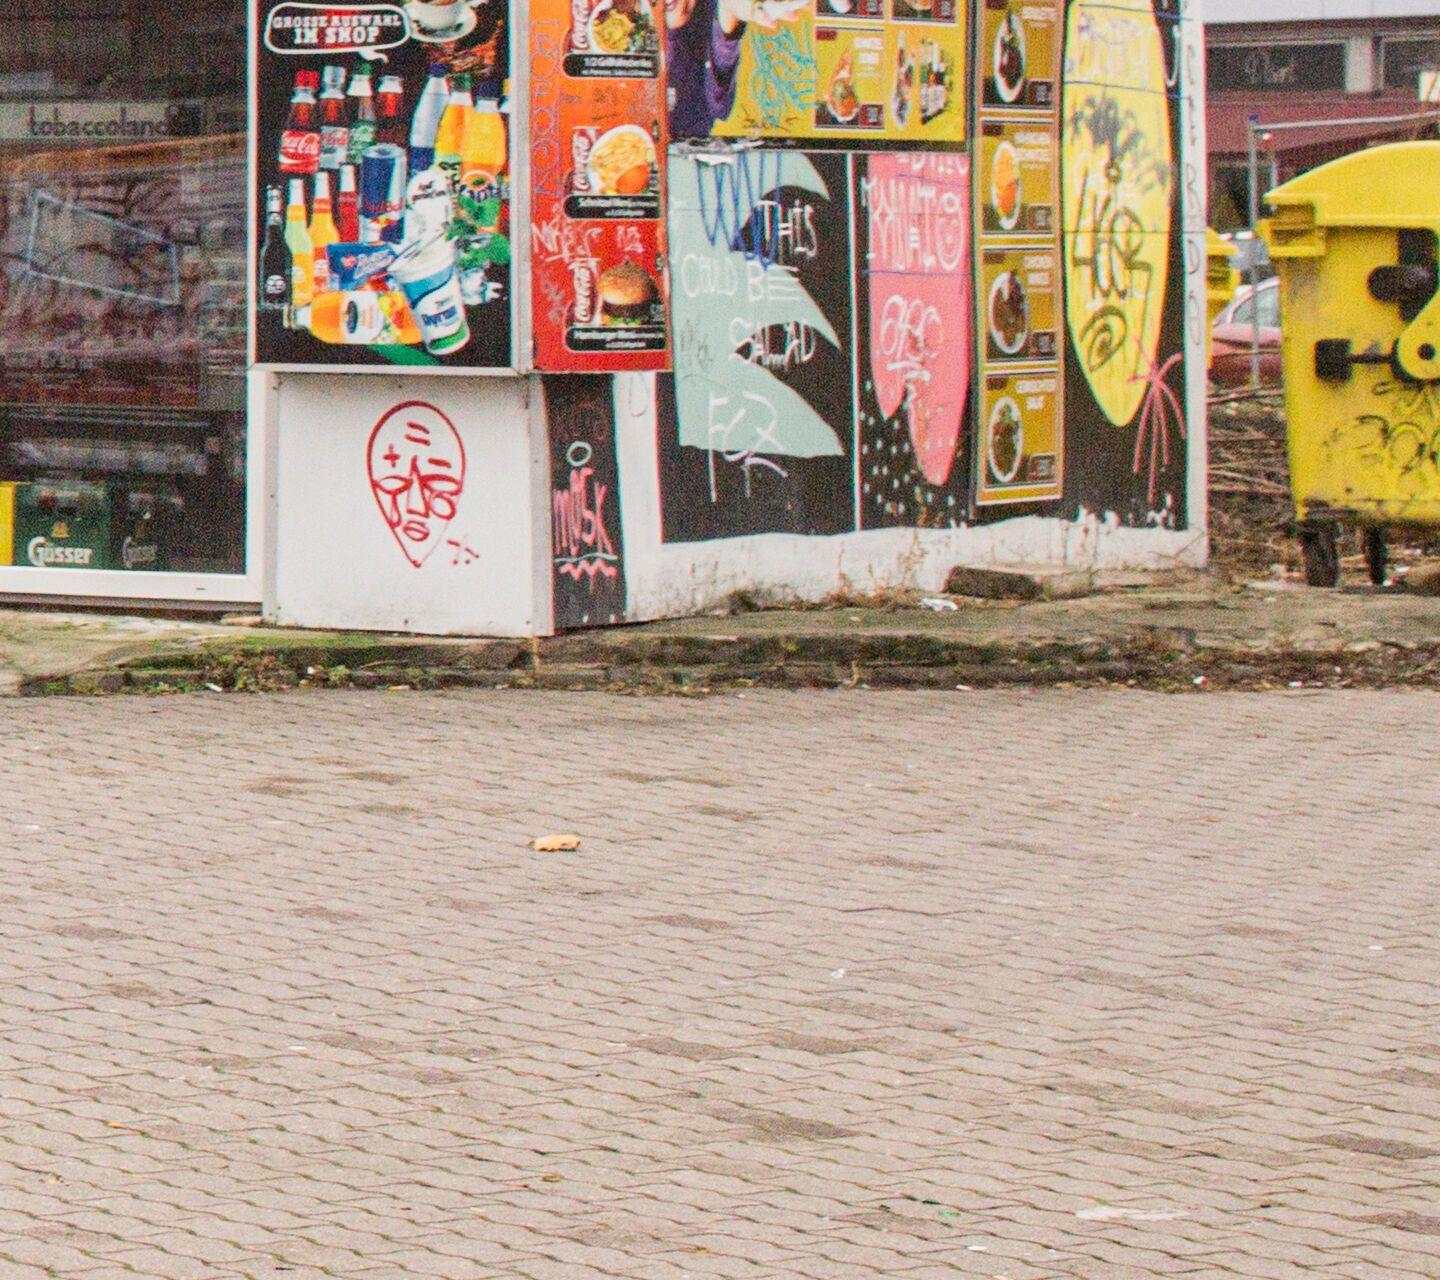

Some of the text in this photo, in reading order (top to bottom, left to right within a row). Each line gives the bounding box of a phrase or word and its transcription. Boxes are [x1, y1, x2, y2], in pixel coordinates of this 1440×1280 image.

[273, 14, 402, 30] GROSSE AUSWAHL
[294, 26, 380, 45] IM SHOP
